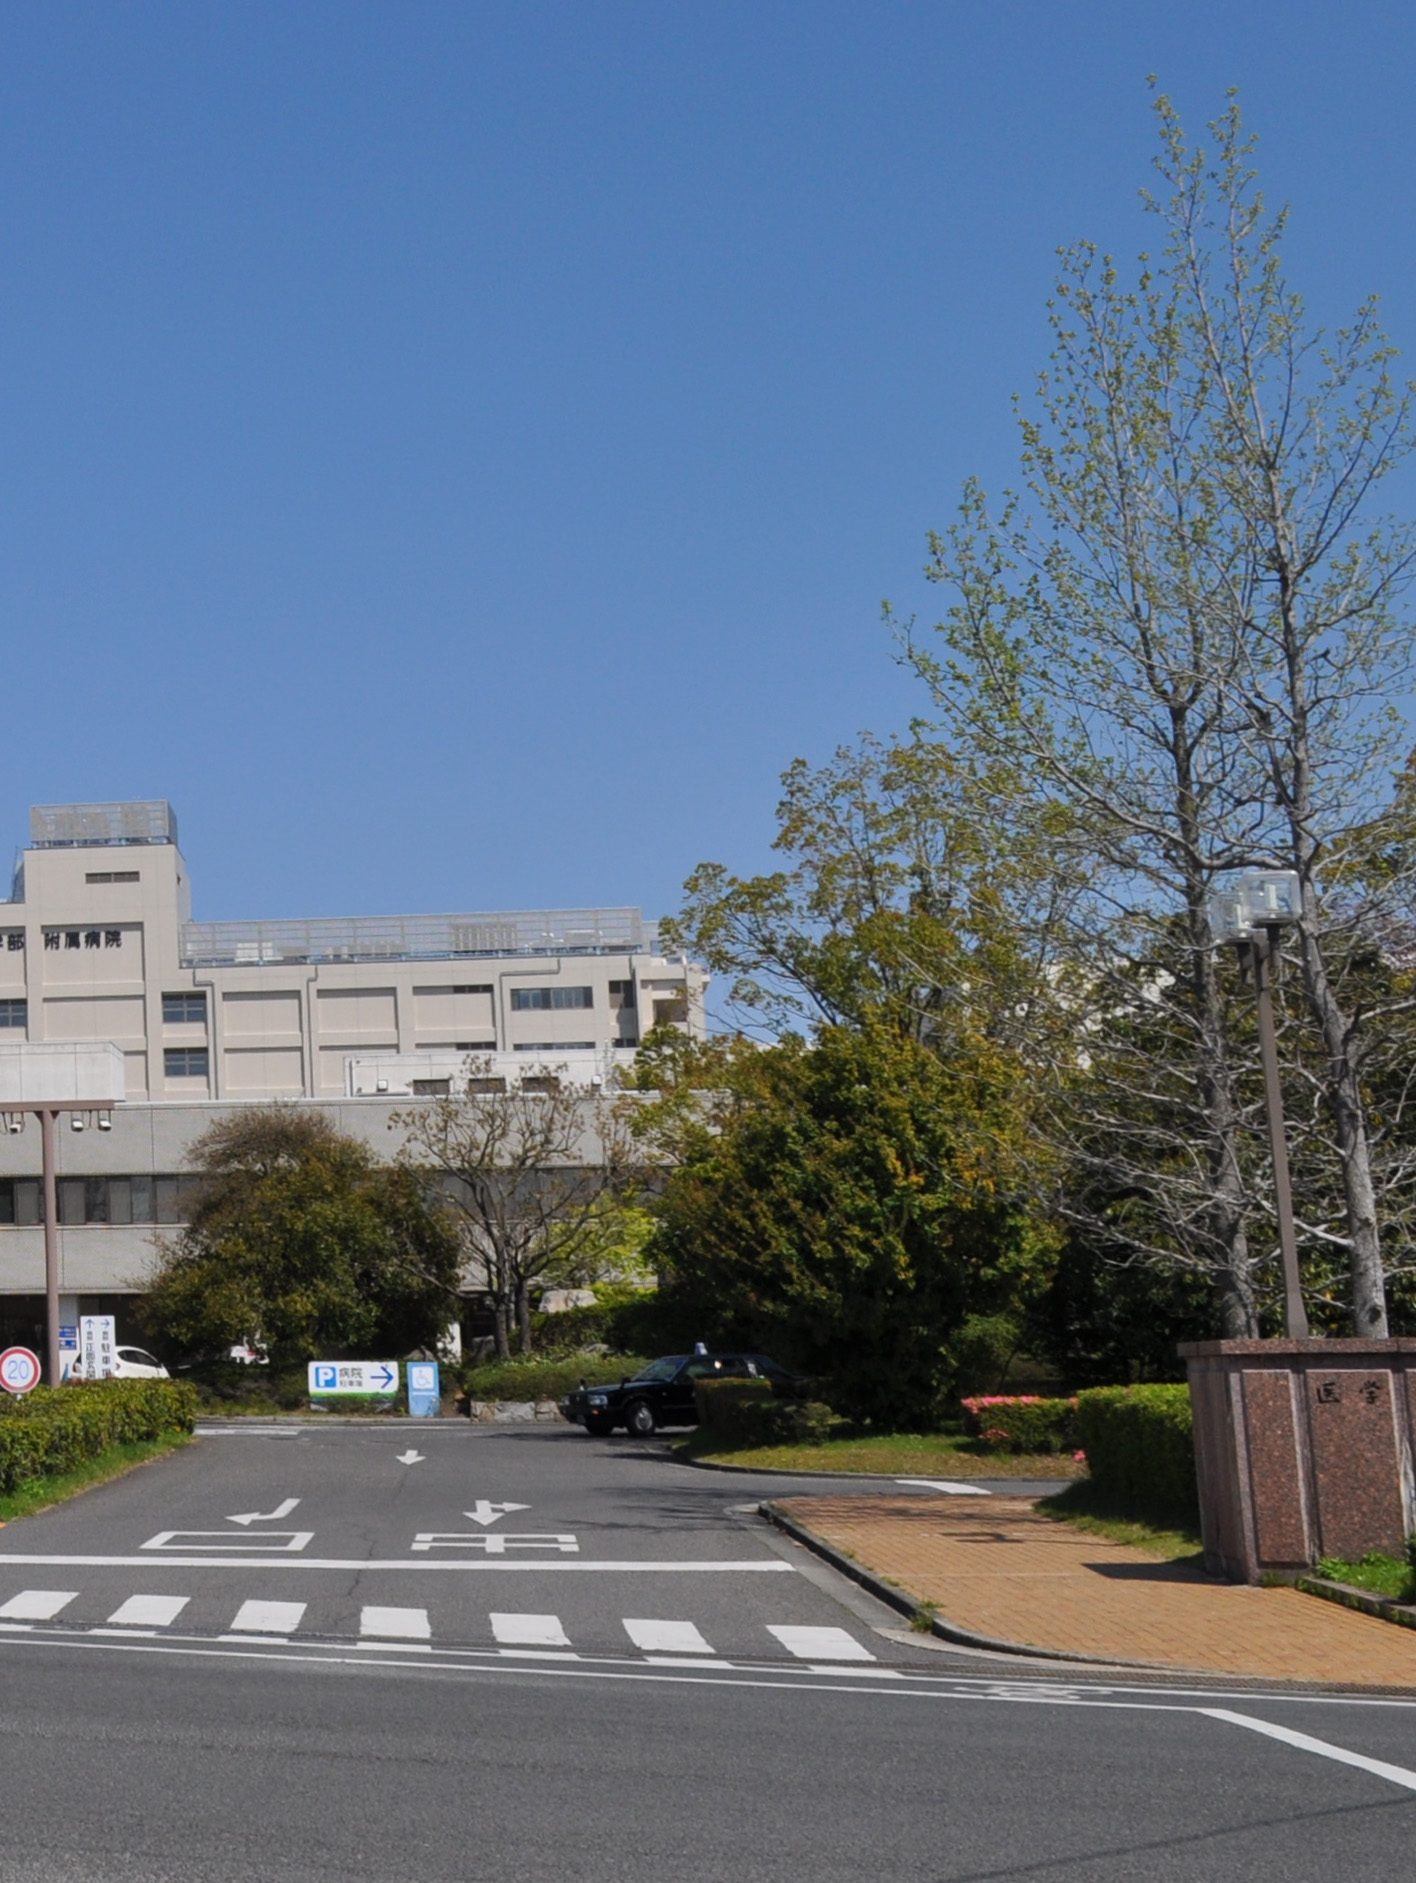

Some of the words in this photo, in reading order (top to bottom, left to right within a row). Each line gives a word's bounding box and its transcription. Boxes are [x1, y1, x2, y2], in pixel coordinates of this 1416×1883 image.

[44, 930, 123, 950] 附属病院
[7, 1360, 30, 1380] 20
[339, 1367, 363, 1379] 病院
[1316, 1380, 1381, 1405] 医学
